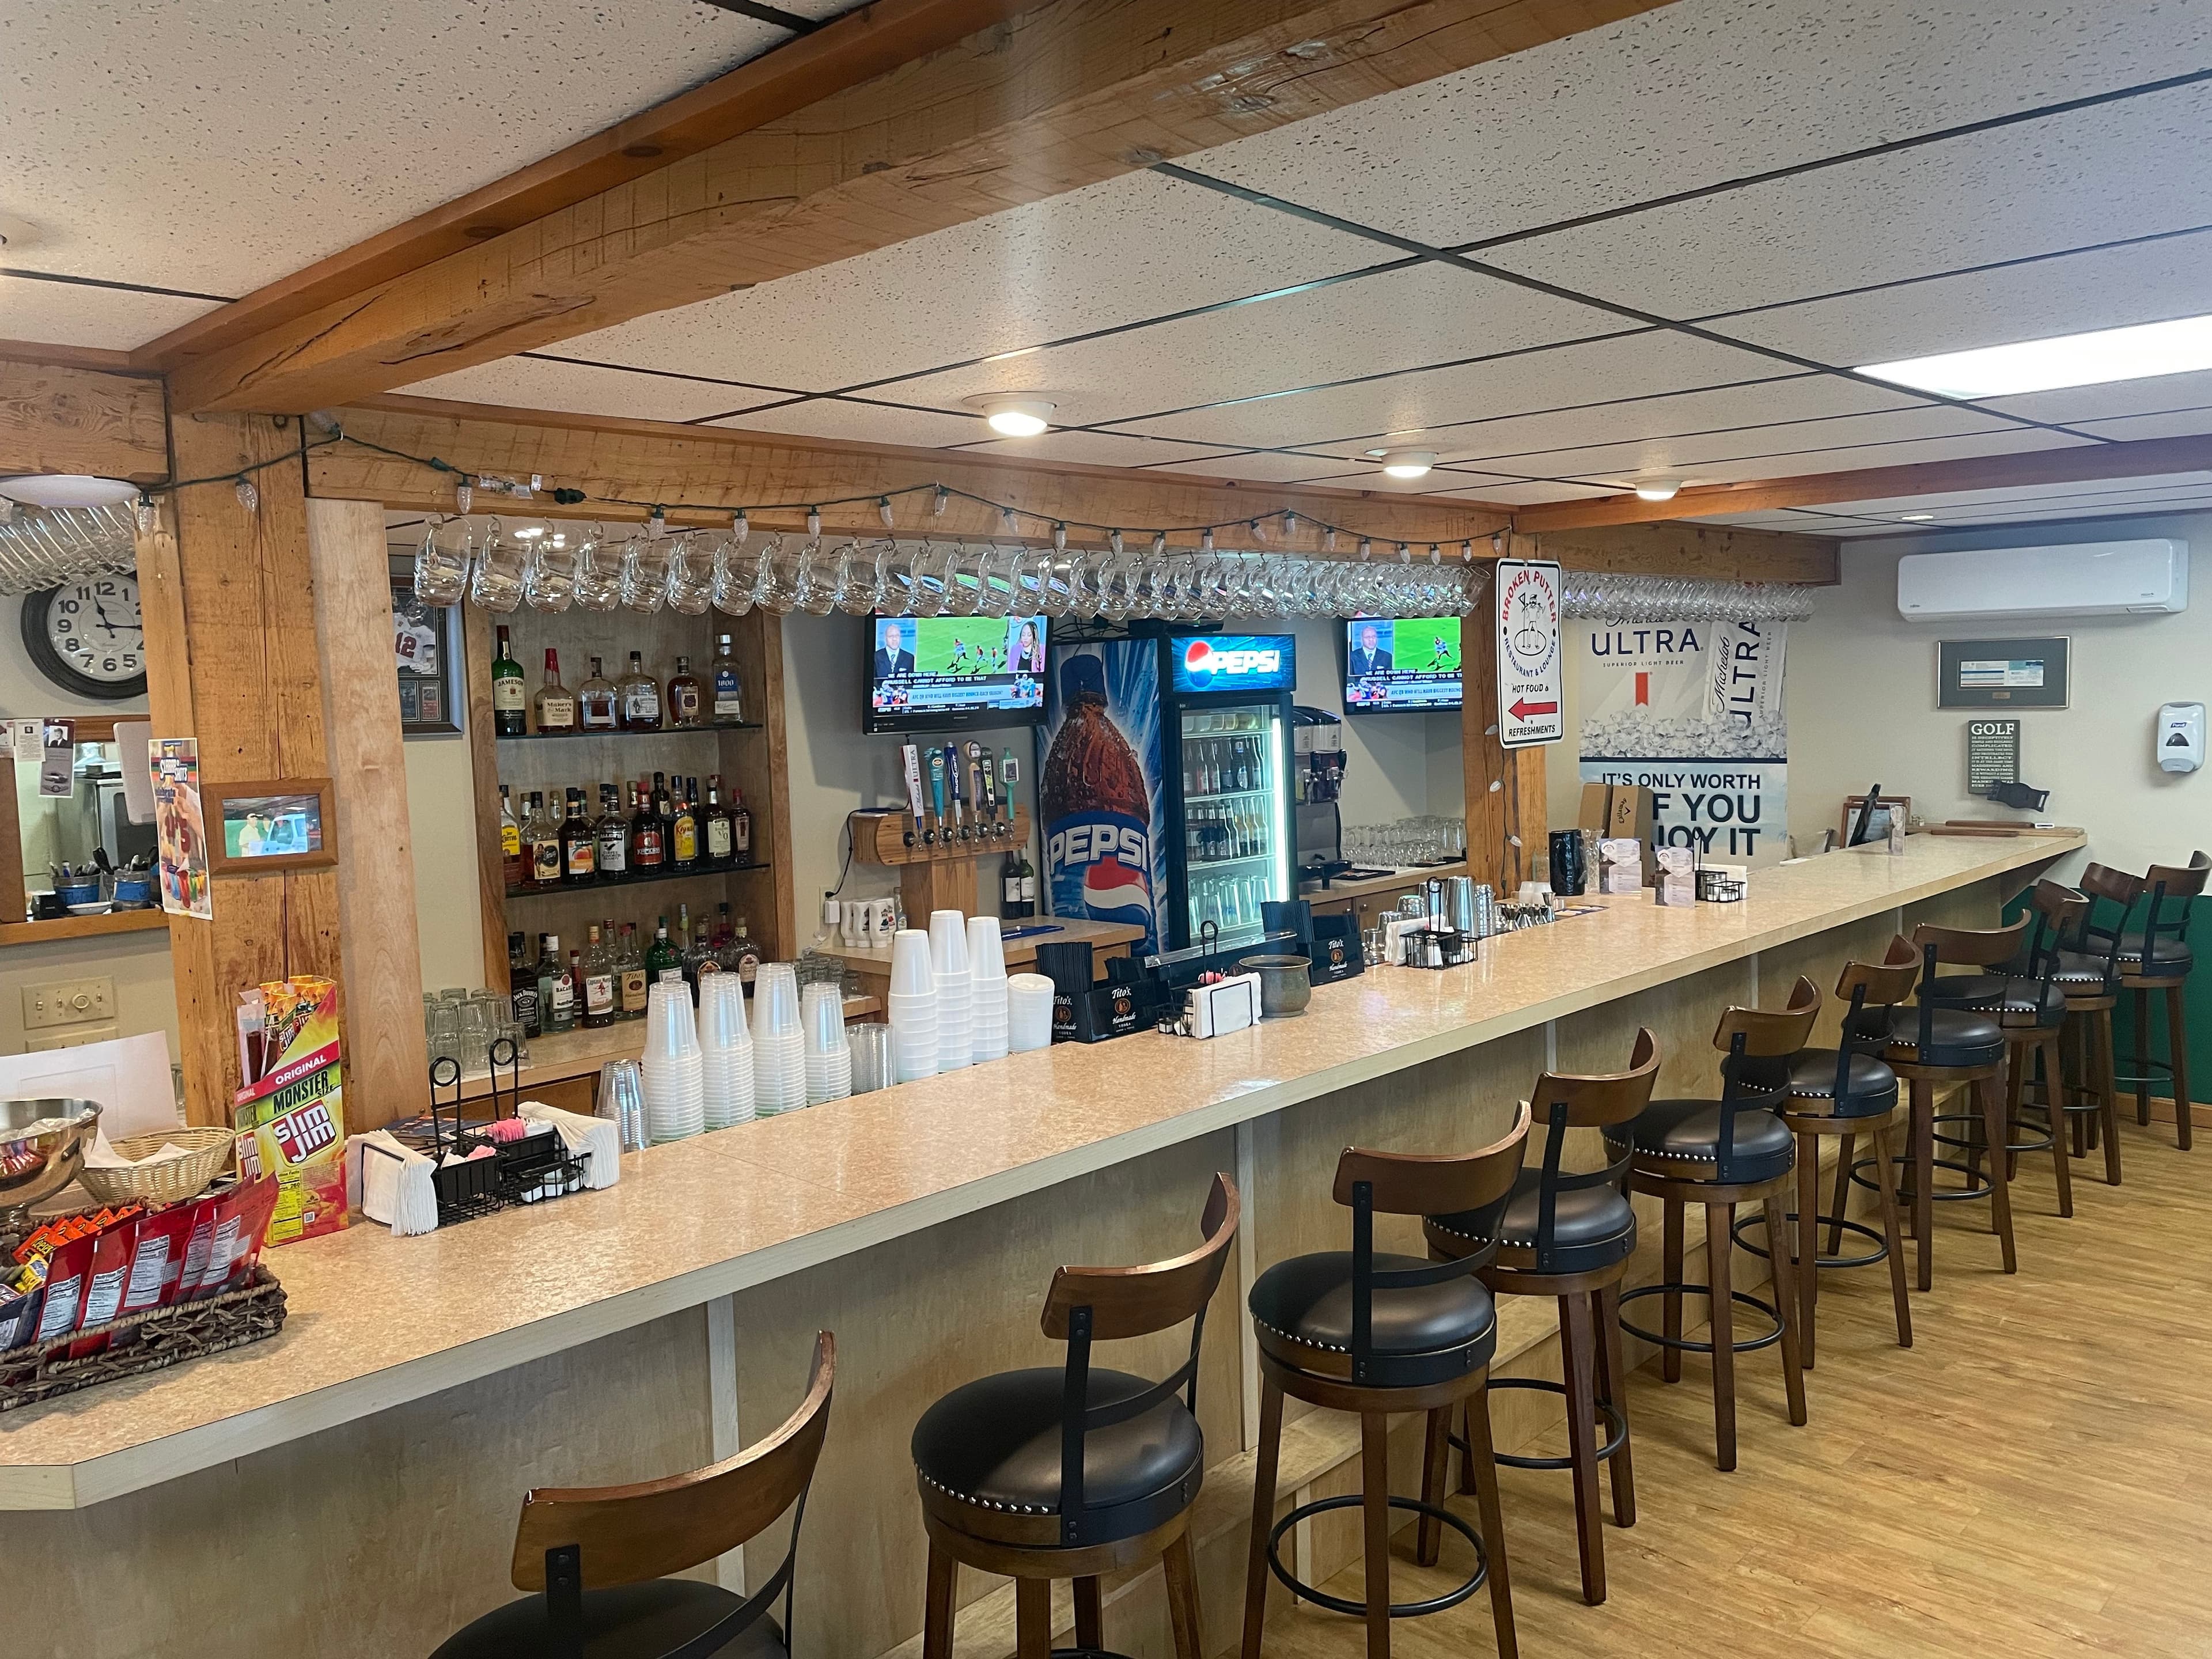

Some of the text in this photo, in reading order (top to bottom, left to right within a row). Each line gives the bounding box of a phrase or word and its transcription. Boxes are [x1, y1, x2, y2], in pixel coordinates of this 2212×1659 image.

[76, 586, 90, 600] 11
[94, 582, 116, 596] 12
[122, 588, 128, 601] 1
[1502, 570, 1556, 623] BROKEN PUTTER
[58, 600, 79, 613] 10
[58, 619, 71, 632] 9
[65, 638, 79, 652] 8
[395, 632, 416, 658] 12
[1592, 628, 1700, 656] ULTRA
[79, 654, 94, 668] 7
[123, 654, 137, 668] 5
[1211, 650, 1281, 675] PEPSI
[1505, 637, 1533, 677] RESTAURANT
[1540, 641, 1555, 673] LOUNGE
[103, 658, 117, 672] 6
[1712, 634, 1730, 713] Michelob
[498, 679, 523, 687] JAMESON
[1513, 685, 1524, 693] HOT
[1526, 684, 1543, 692] FOOD
[1509, 725, 1555, 736] REFRESHMENTS
[1971, 724, 2014, 734] GOLF
[1603, 773, 1760, 789] IT'S ONLY WORTH
[1653, 793, 1760, 823] F YOU
[1651, 825, 1718, 854] JOY
[1730, 828, 1761, 856] IT
[1050, 824, 1147, 875] PEPSI
[1328, 939, 1344, 949] Tito's
[1112, 987, 1132, 999] Tito's
[275, 1055, 327, 1085] ORIGINAL
[273, 1070, 335, 1114] MONSTER SIZE
